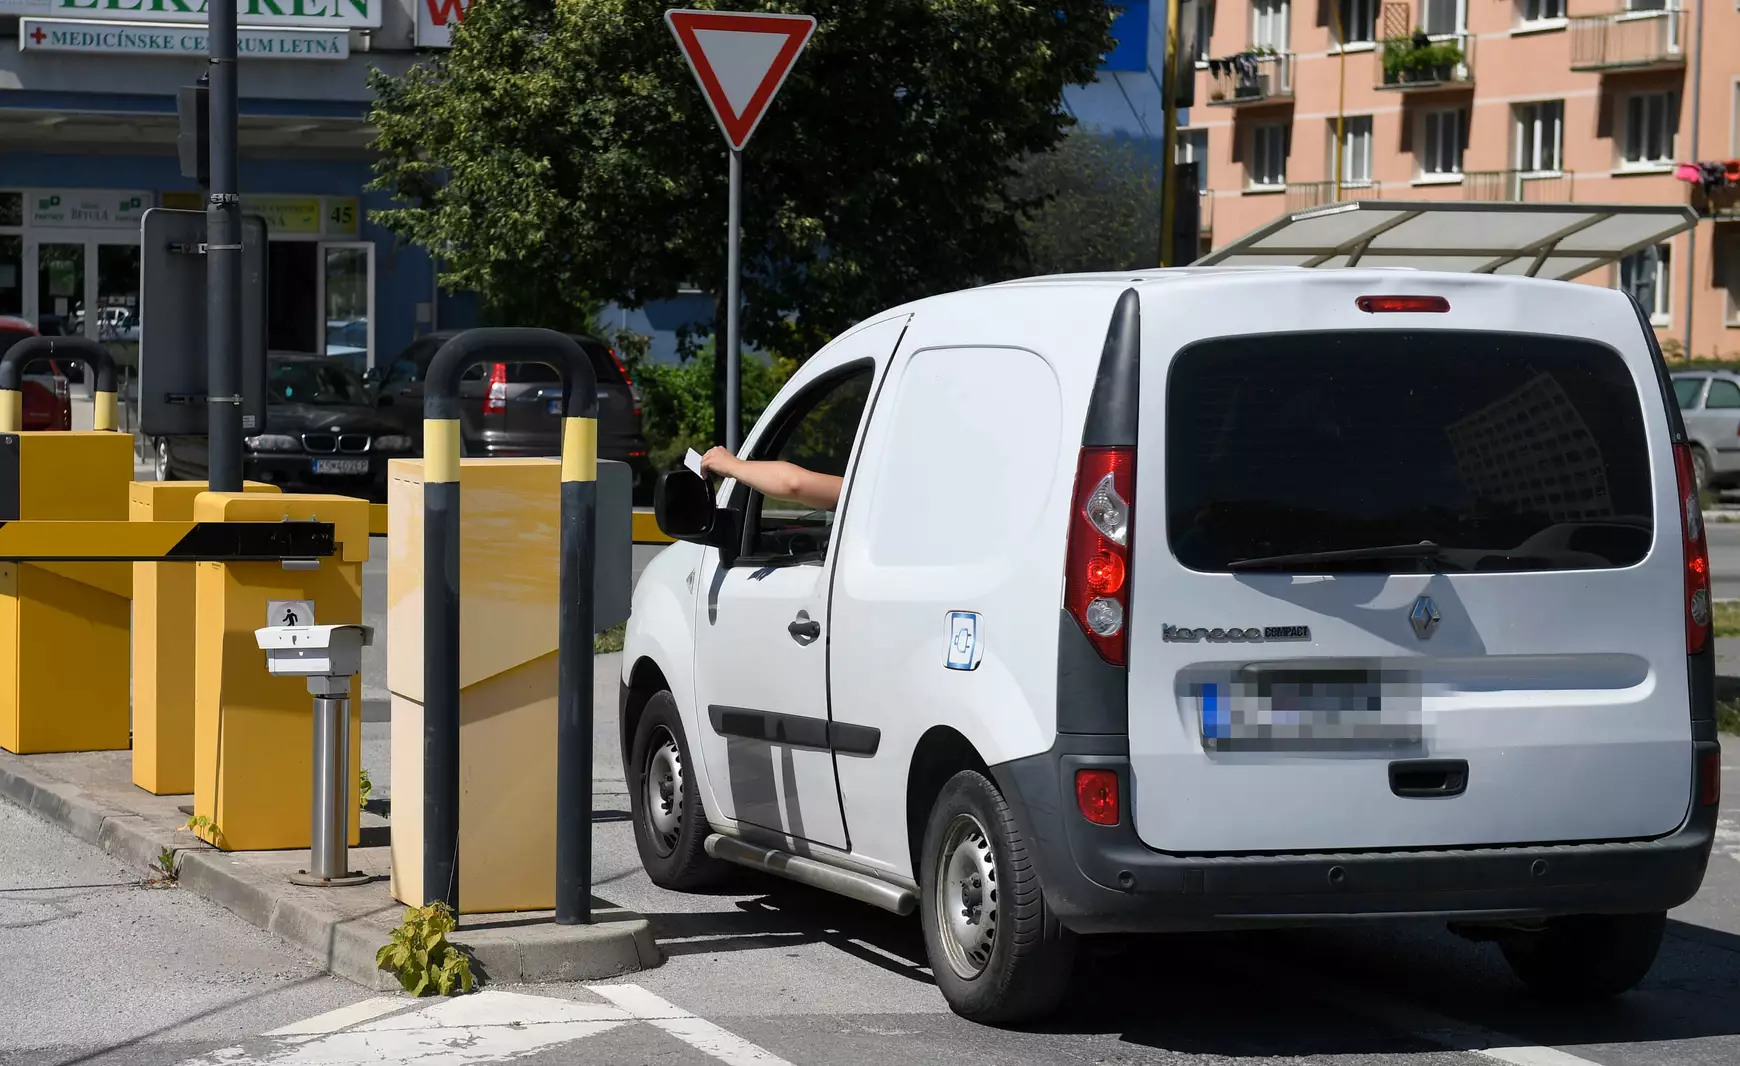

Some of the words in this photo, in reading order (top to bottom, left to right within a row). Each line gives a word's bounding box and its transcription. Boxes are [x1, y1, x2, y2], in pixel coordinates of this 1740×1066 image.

[51, 30, 175, 50] MEDICÍNSKE
[180, 35, 272, 53] CERUM
[279, 37, 340, 54] LETNÁ
[331, 207, 353, 224] 45
[1264, 626, 1308, 638] COMPACT
